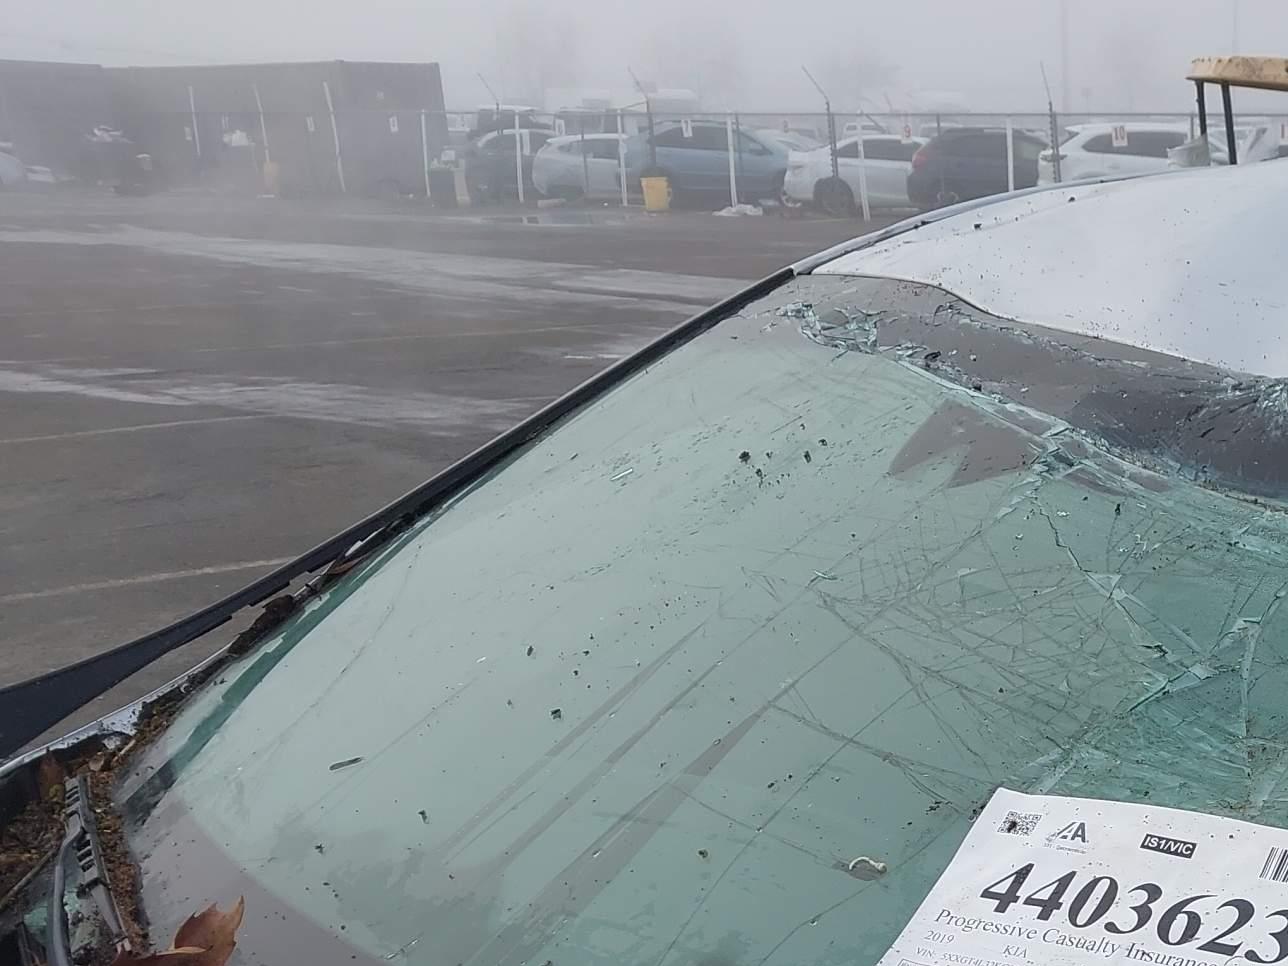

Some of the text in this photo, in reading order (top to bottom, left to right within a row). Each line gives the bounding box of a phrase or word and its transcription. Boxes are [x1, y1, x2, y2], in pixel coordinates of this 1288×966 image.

[1144, 836, 1194, 855] IS1/VIC
[924, 930, 955, 944] 2019
[934, 909, 1038, 940] Progressive
[1042, 927, 1121, 957] Casualty
[1003, 945, 1028, 959] KIA
